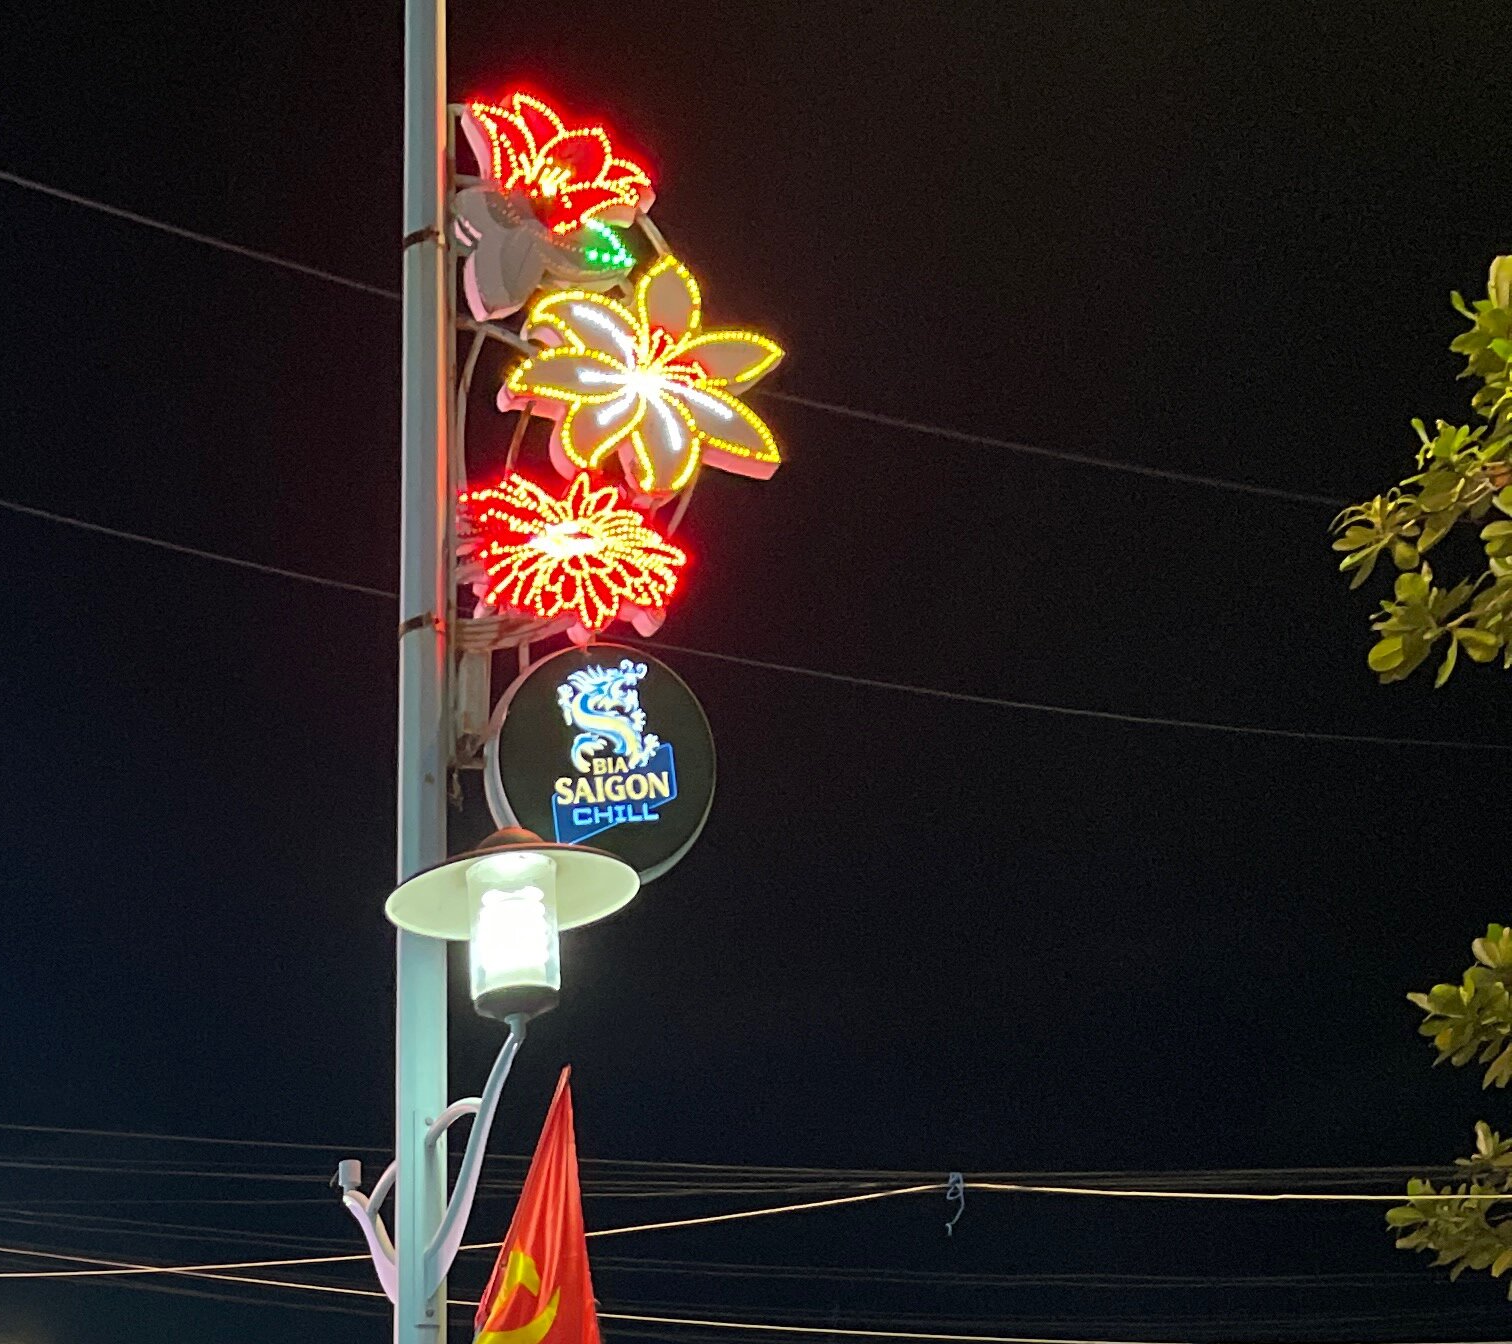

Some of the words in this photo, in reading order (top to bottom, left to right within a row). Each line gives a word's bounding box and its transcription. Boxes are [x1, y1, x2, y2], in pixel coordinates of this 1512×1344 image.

[592, 756, 629, 775] BIA
[554, 771, 670, 805] SAIGON
[572, 802, 660, 826] CHILL
